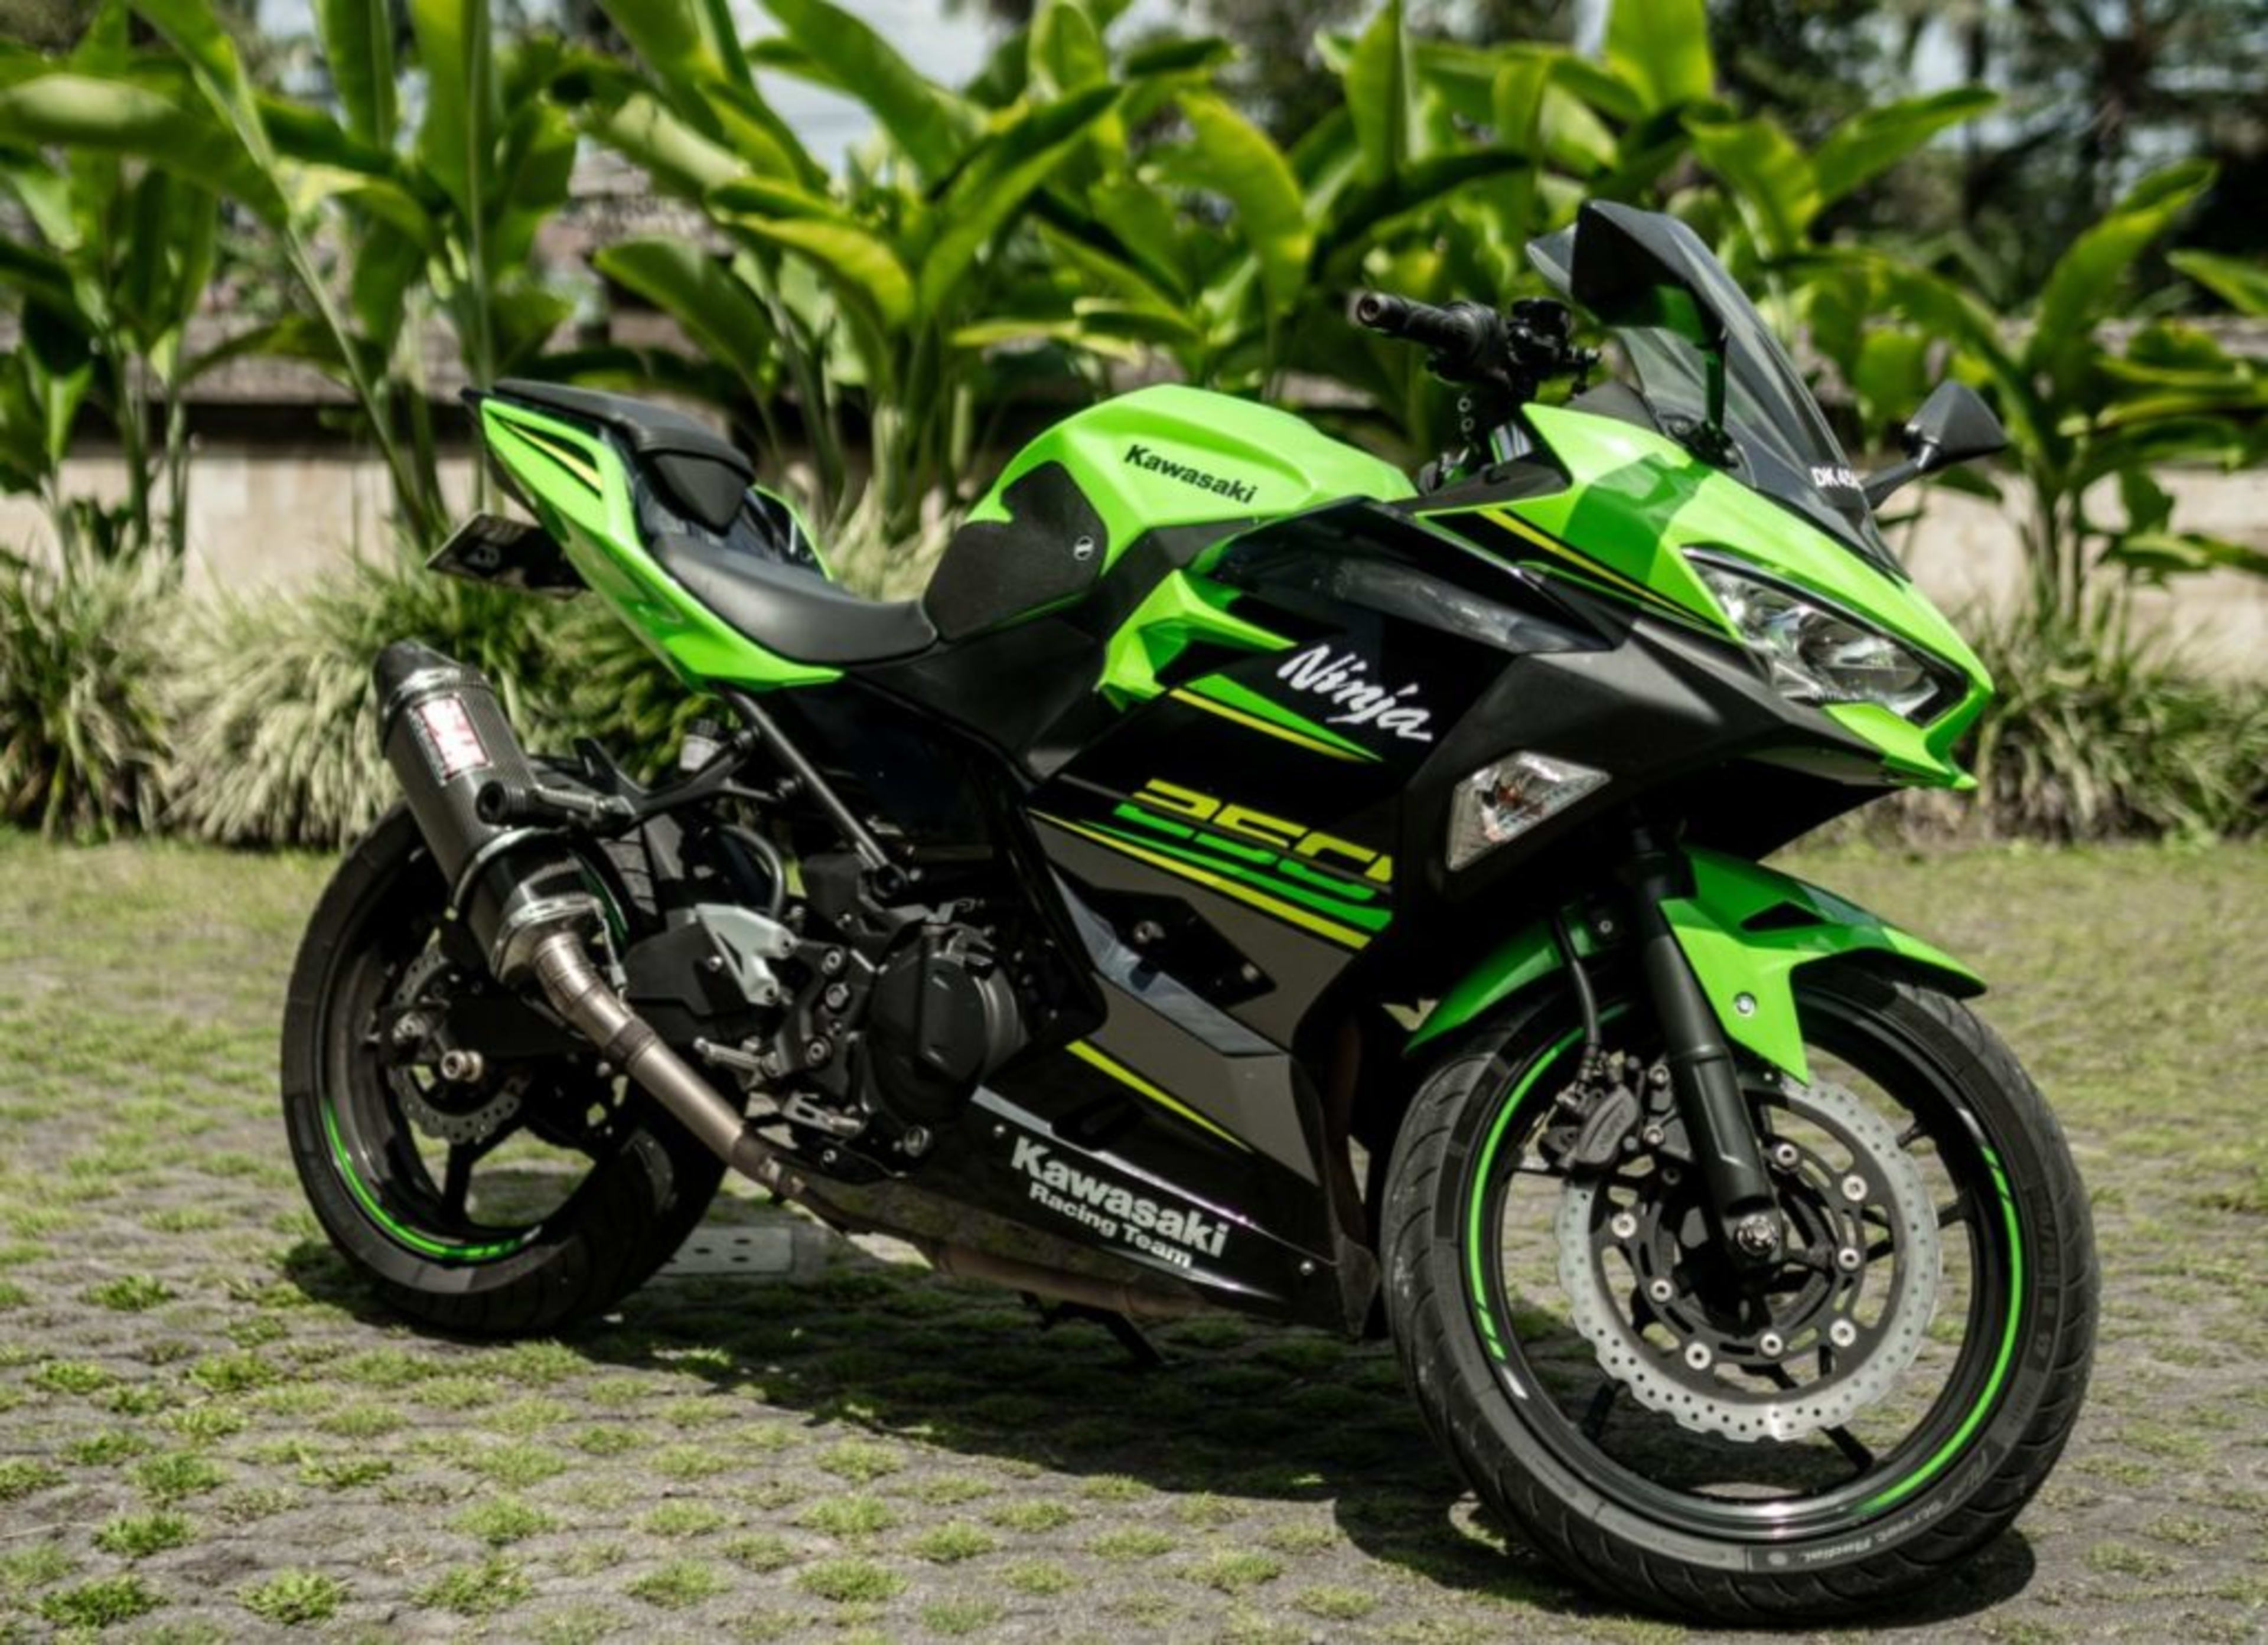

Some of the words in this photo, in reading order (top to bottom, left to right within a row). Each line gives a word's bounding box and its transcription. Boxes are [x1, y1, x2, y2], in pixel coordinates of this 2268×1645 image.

[1124, 444, 1258, 504] Kawasaki
[1276, 644, 1433, 742] Ninja
[1113, 778, 1393, 901] 250
[1011, 1135, 1229, 1258] Kawasaki
[1029, 1181, 1117, 1238] Racing
[1122, 1223, 1193, 1269] Team
